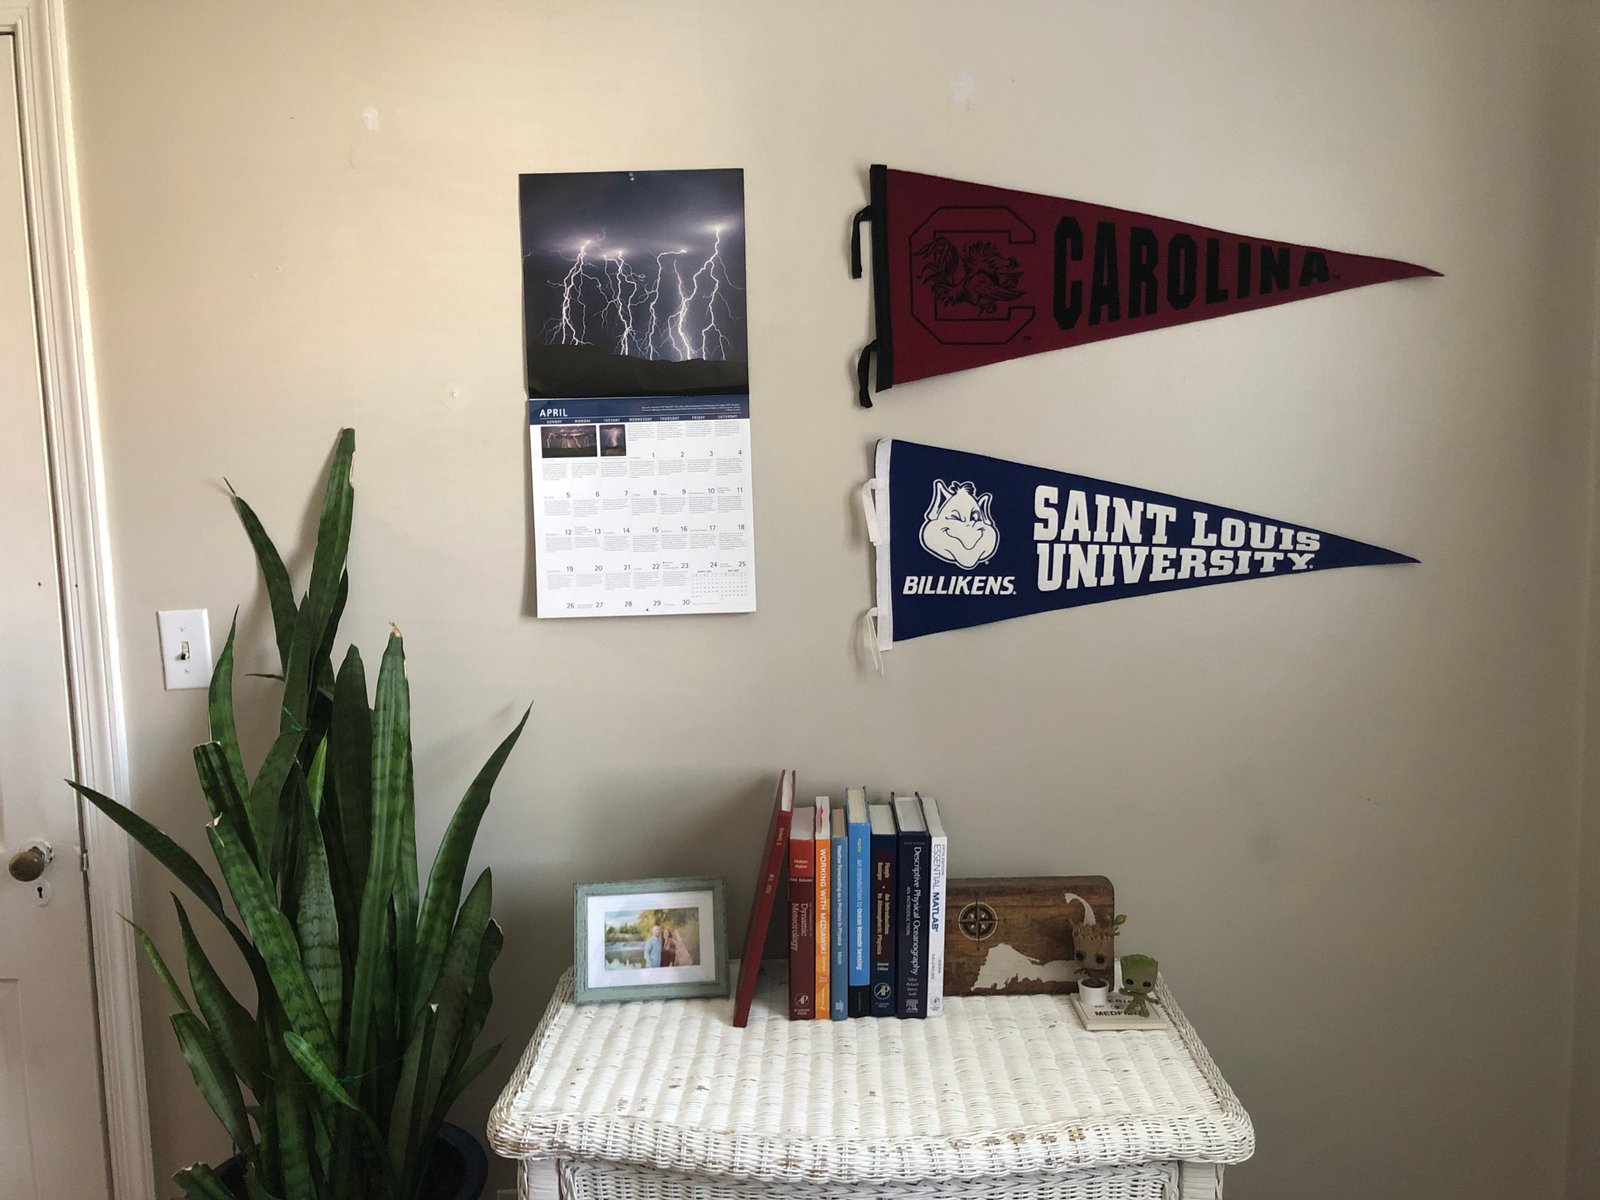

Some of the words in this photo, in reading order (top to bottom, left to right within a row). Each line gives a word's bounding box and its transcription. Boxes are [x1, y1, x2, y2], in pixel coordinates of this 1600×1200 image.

[1053, 216, 1331, 330] CAROLINA
[539, 409, 567, 417] APRIL
[1033, 485, 1176, 543] SAINT
[1191, 510, 1320, 551] LOUIS
[1036, 542, 1313, 591] UNIVERSITY
[856, 859, 862, 867] An
[913, 847, 922, 888] Descriptive
[933, 844, 941, 889] ESSENTIAL
[906, 886, 910, 894] AN
[911, 890, 921, 918] Physical
[790, 903, 799, 951] Meteorology
[799, 903, 808, 936] Dynamic
[911, 920, 921, 975] Oceanography
